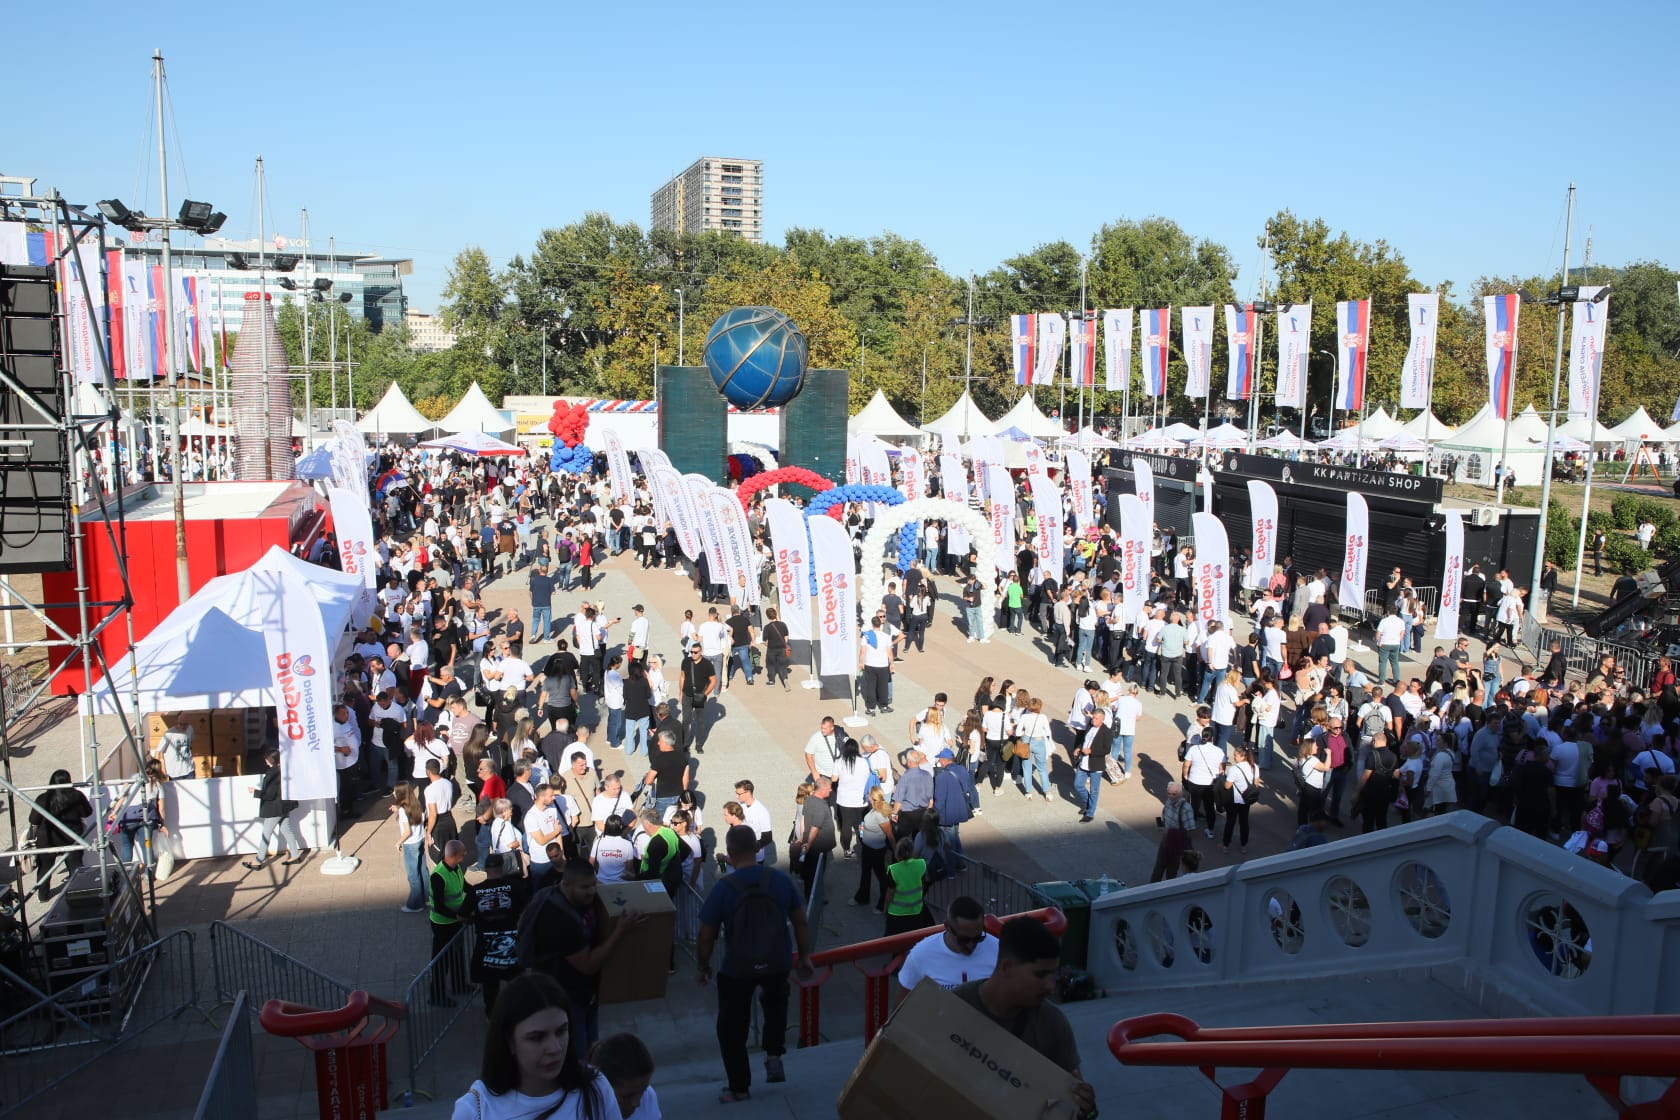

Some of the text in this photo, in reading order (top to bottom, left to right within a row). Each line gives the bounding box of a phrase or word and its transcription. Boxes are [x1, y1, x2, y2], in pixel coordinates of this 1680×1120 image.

[1313, 467, 1421, 490] KK PARTIZAN SHOP
[475, 884, 512, 897] PHNTM
[950, 1033, 1022, 1088] explode
